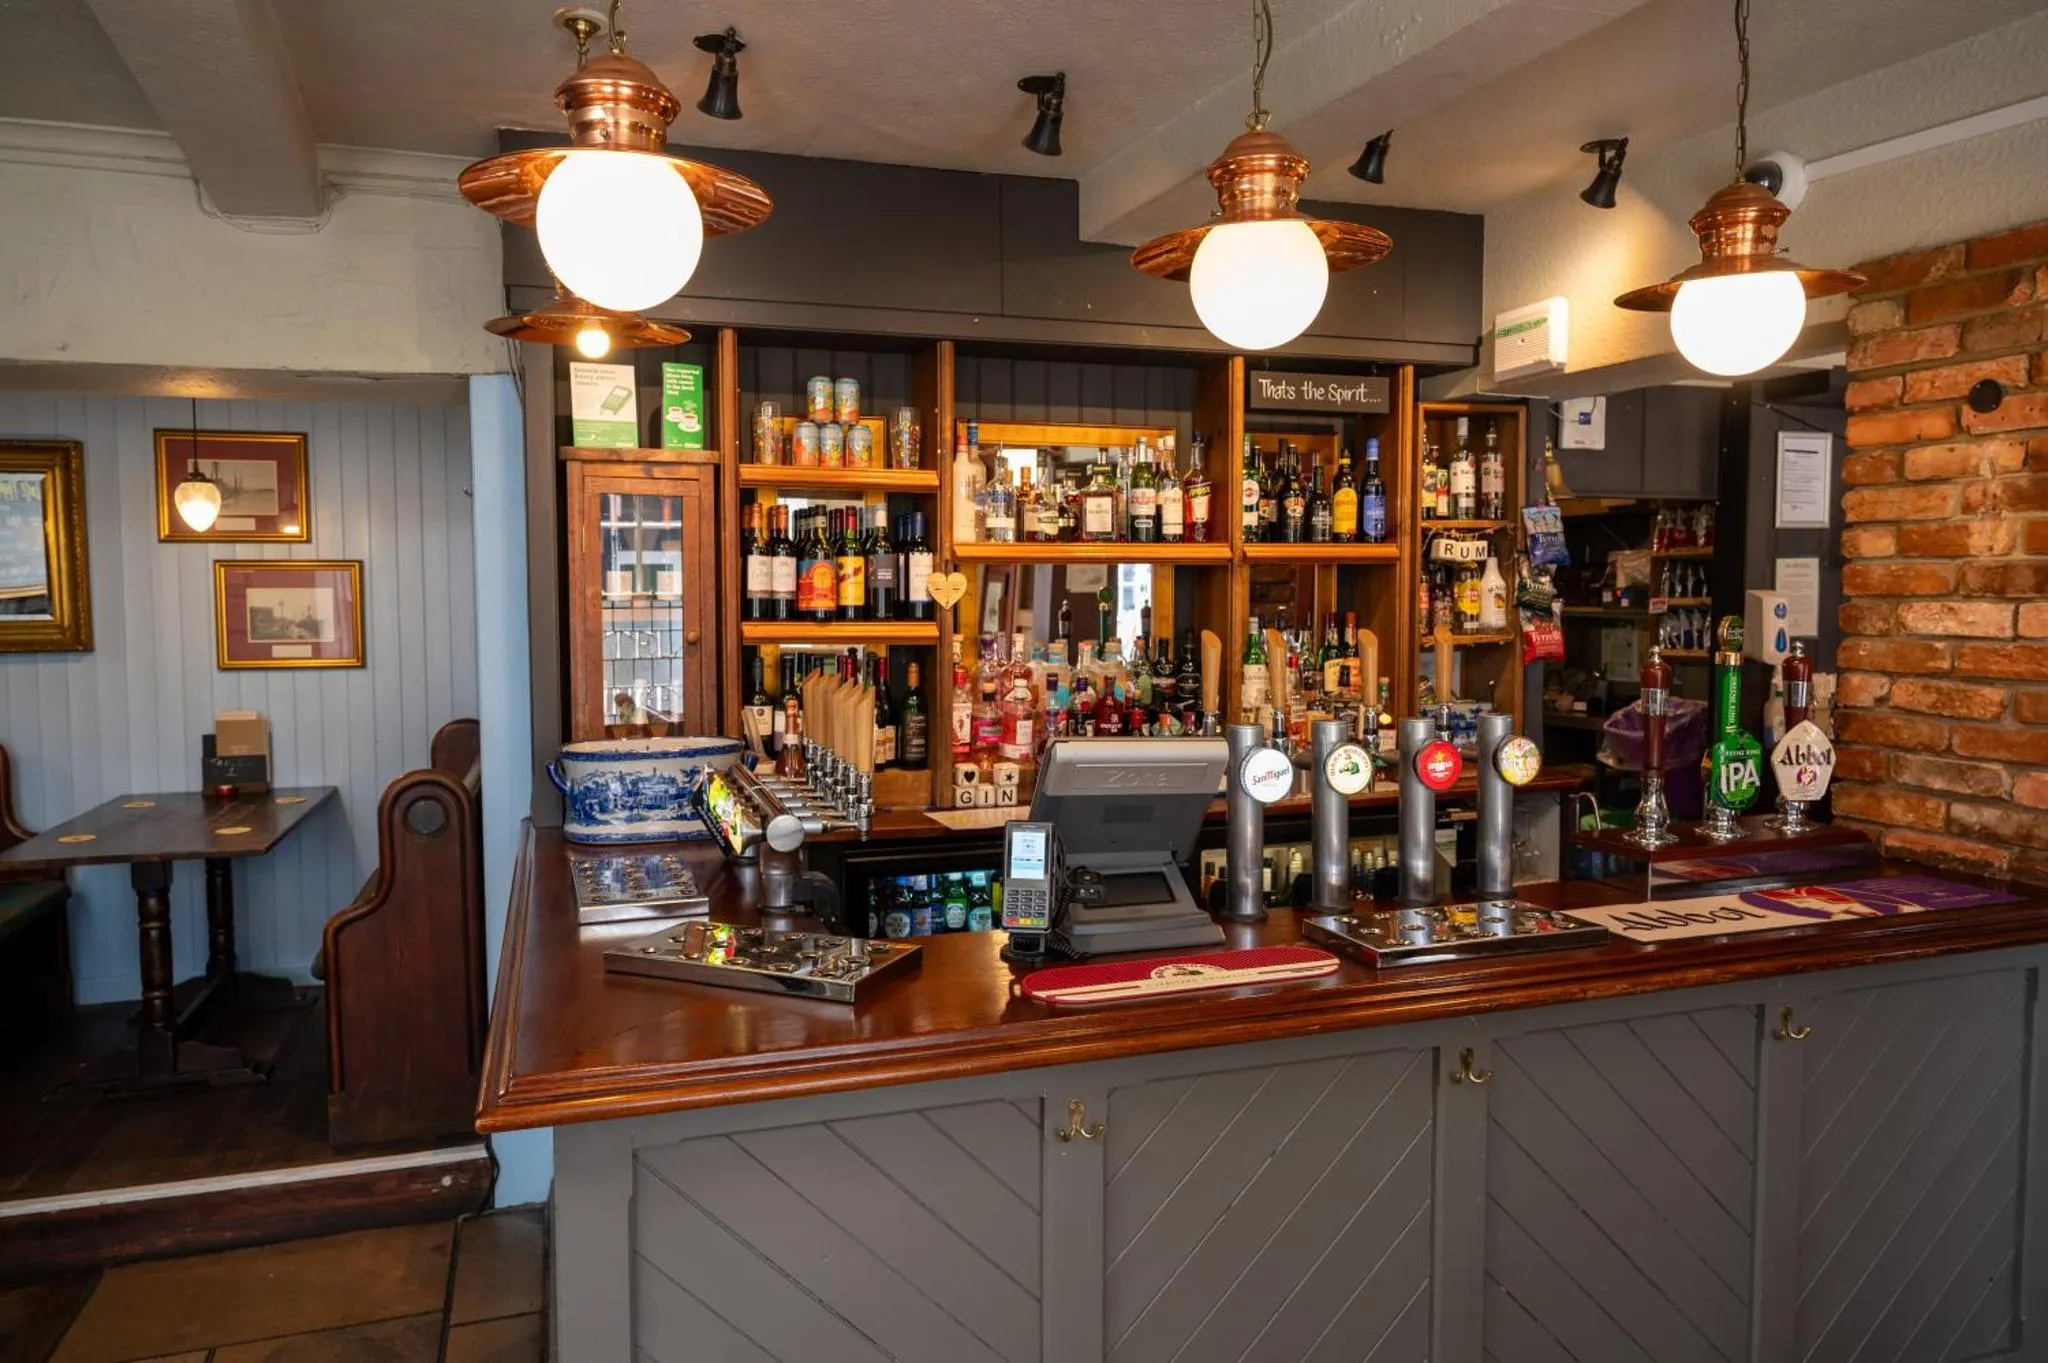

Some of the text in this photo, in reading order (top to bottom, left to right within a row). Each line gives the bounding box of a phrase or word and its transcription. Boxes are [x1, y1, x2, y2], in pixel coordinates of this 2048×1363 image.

[1301, 380, 1325, 400] the
[1444, 543, 1486, 559] RUM
[1720, 759, 1761, 794] IPA
[960, 789, 1013, 804] GIN
[1606, 906, 1768, 932] Abbot
